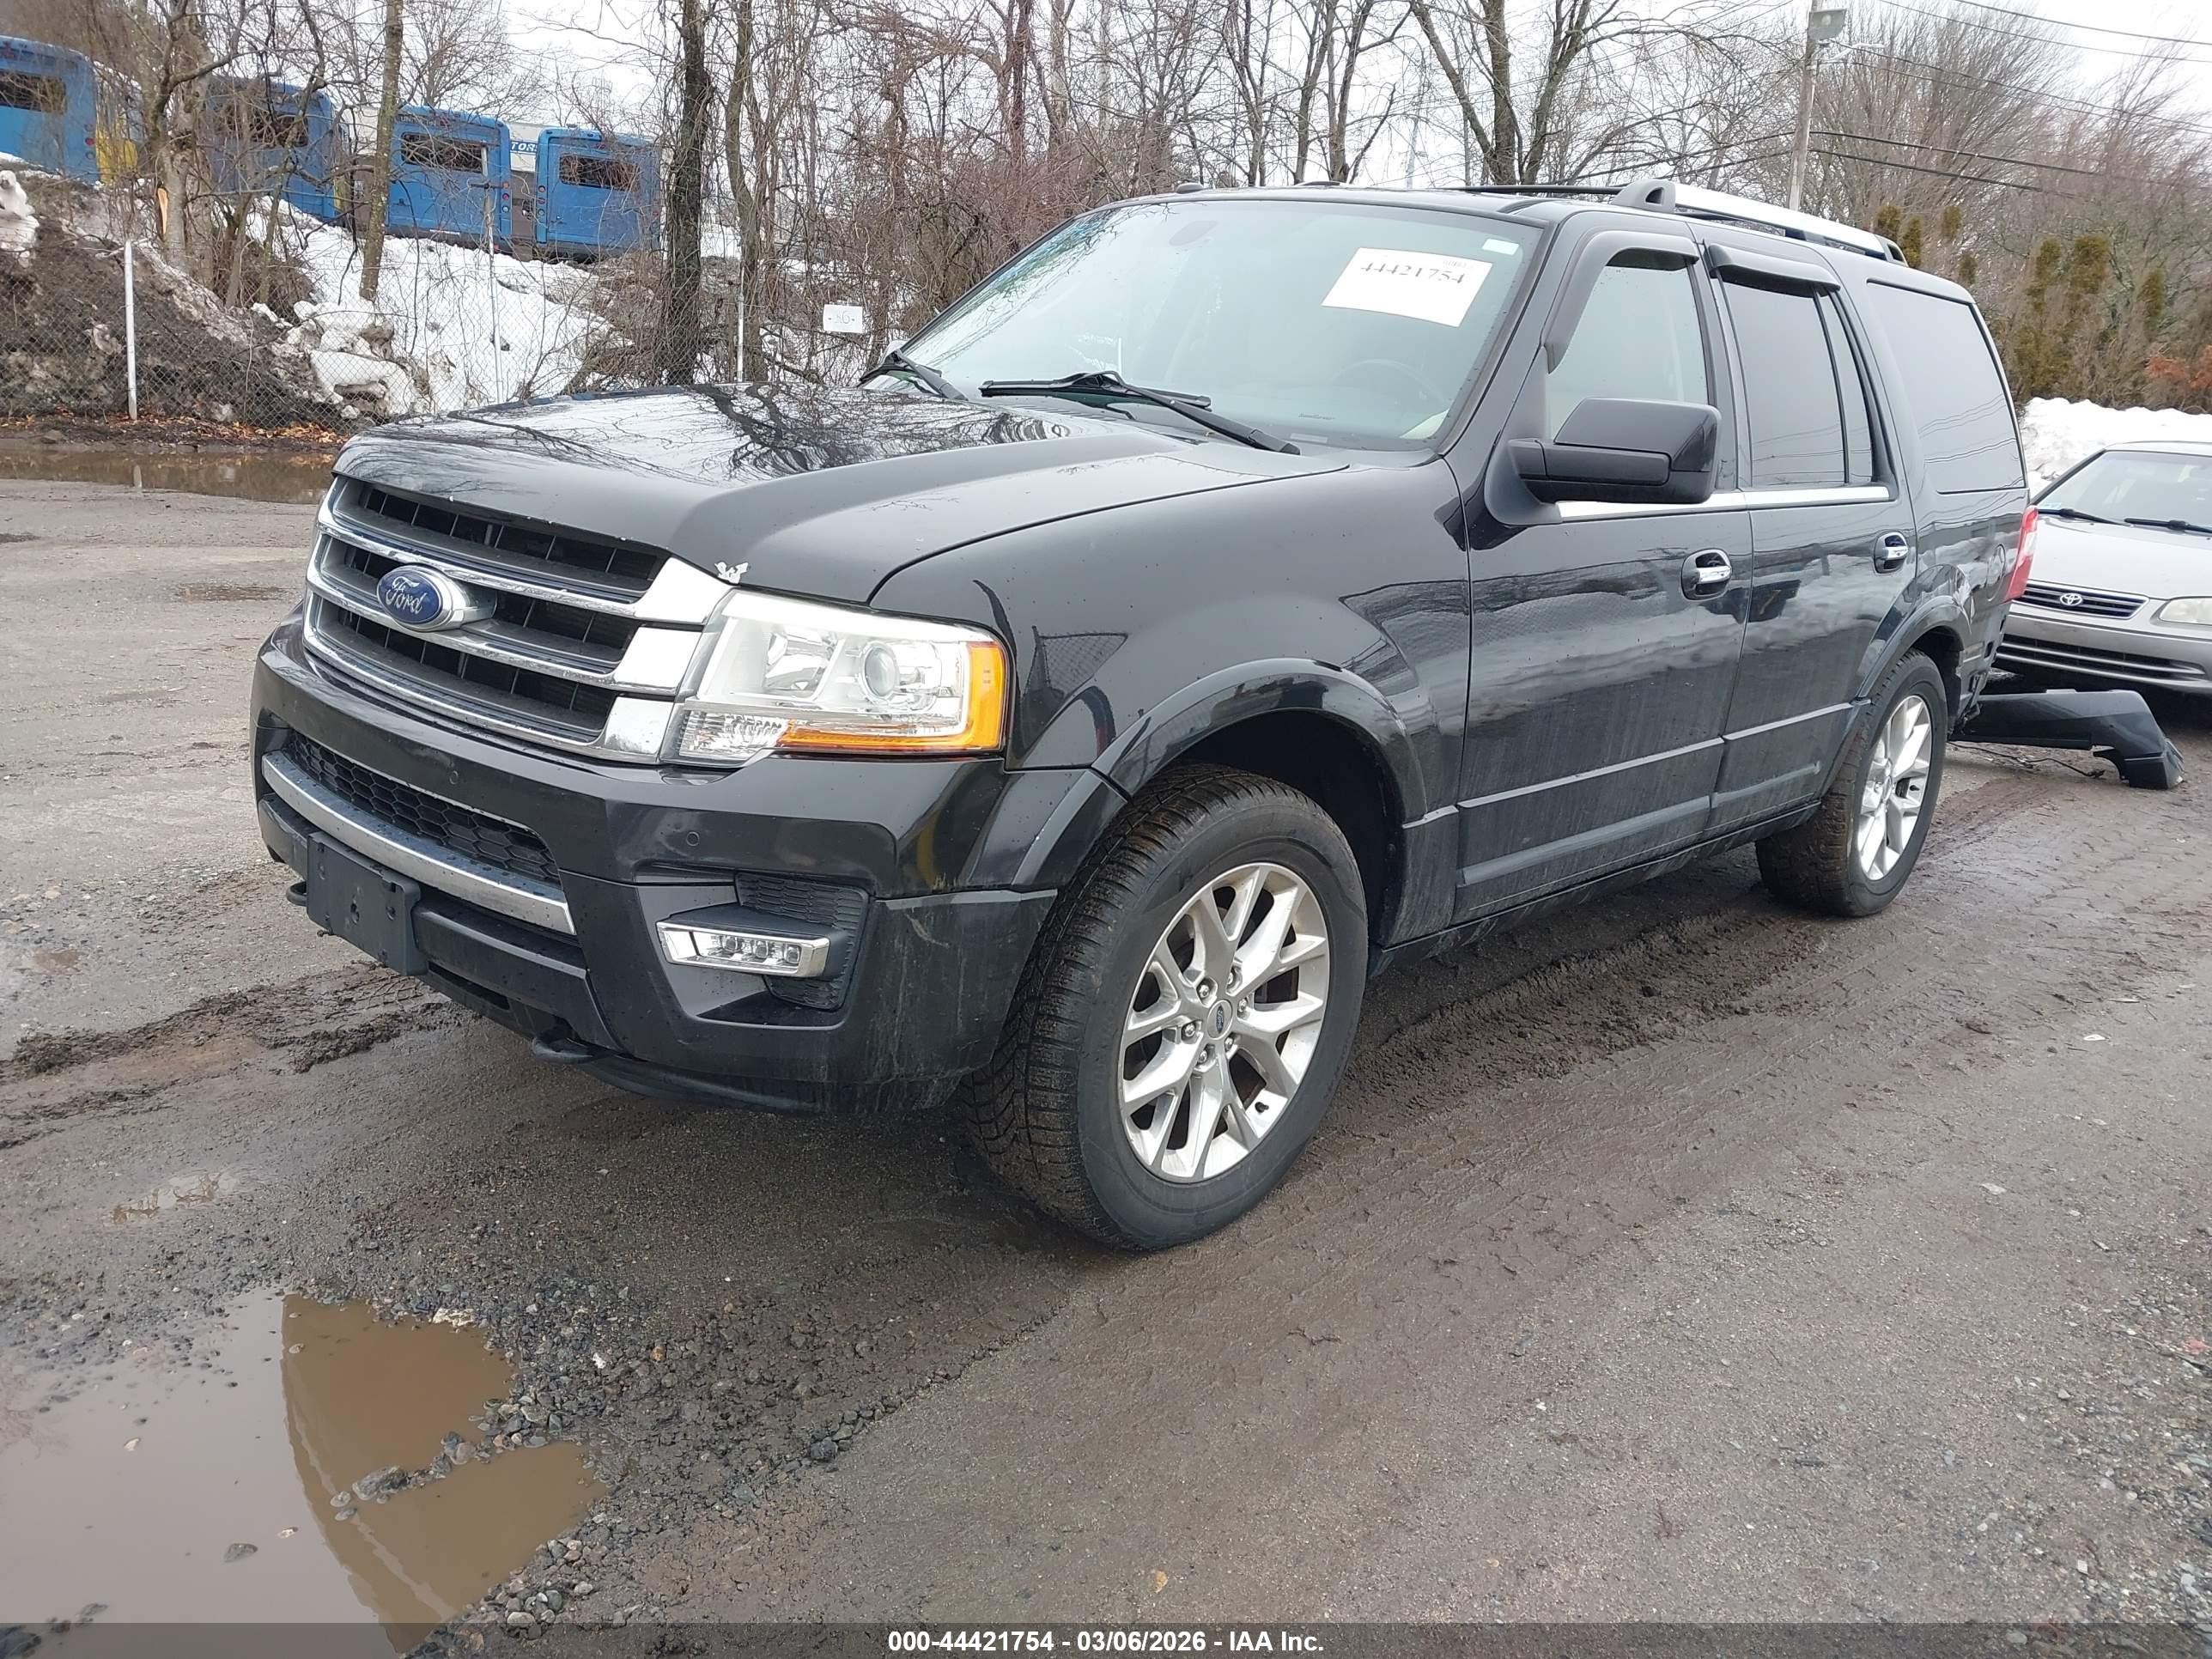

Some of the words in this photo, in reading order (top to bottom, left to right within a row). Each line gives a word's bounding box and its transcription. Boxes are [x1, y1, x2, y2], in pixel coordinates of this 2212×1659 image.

[511, 142, 538, 152] TOR
[1360, 262, 1466, 284] 44421754
[385, 575, 428, 615] Ford
